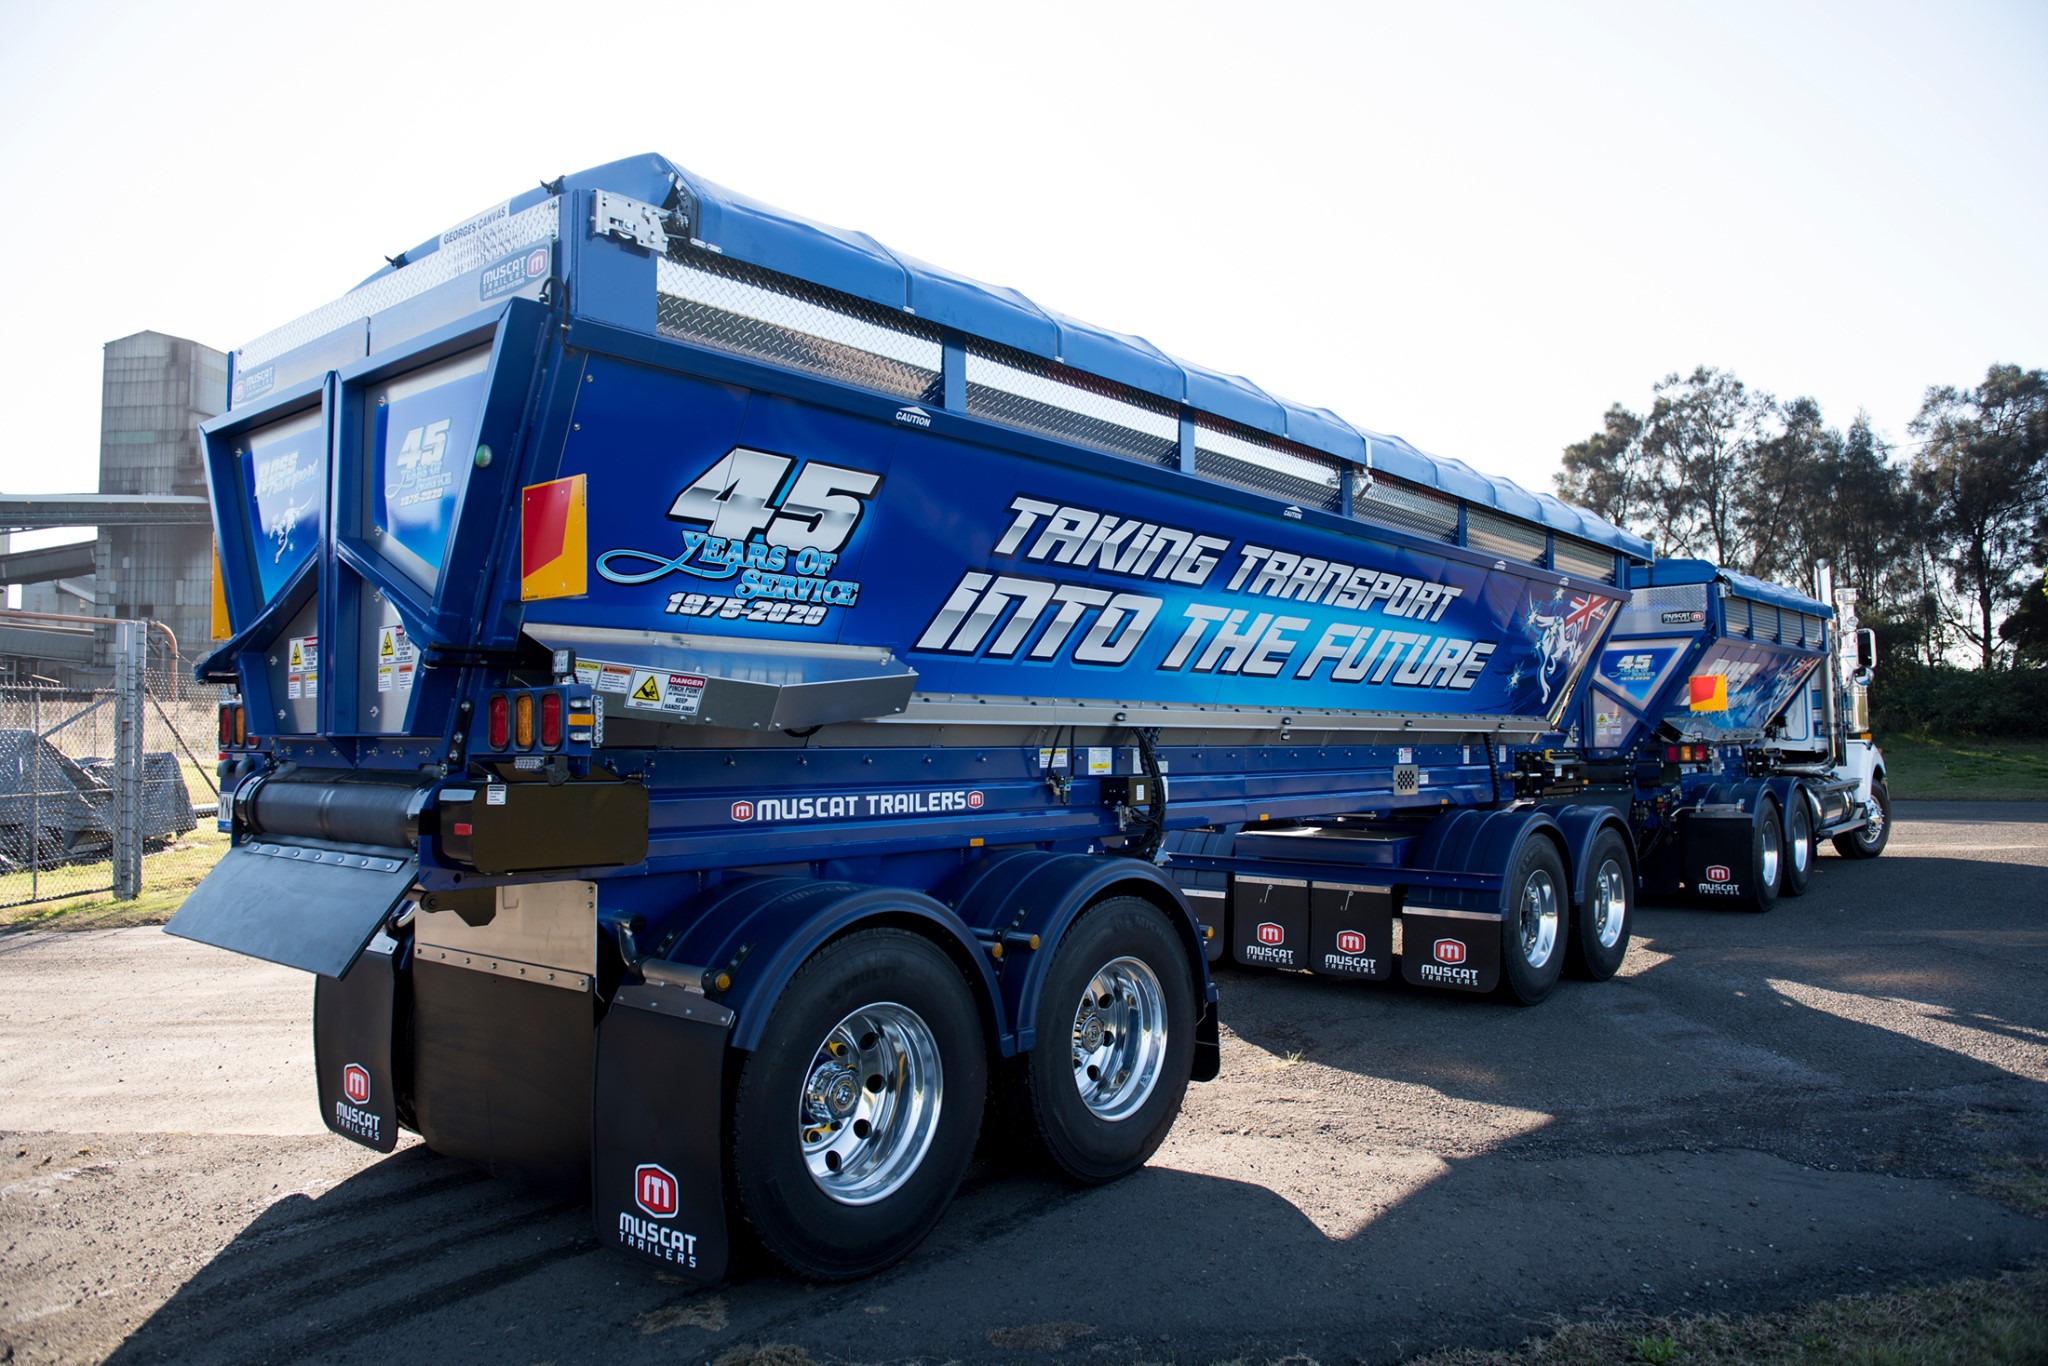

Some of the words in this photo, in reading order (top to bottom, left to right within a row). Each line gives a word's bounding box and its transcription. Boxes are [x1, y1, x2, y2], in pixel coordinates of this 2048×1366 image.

[443, 222, 476, 245] GEORGES
[477, 206, 506, 230] CANVAS
[483, 255, 526, 285] MUSCAT
[483, 269, 526, 292] TRAILERS
[895, 411, 931, 428] CAUTION
[396, 418, 451, 470] 45
[667, 446, 882, 552] 45
[795, 547, 838, 577] OF
[994, 496, 1230, 585] TAKING
[1226, 545, 1463, 622] TRANSPORT
[735, 568, 860, 607] SERVICE
[664, 592, 828, 626] 1975-2020
[915, 571, 1163, 662] INTO
[1162, 603, 1312, 675] THE
[1296, 622, 1498, 689] FUTURE
[1617, 654, 1653, 670] 45
[669, 684, 685, 692] PINCH
[685, 687, 701, 695] POINT
[670, 676, 704, 687] DANGER
[664, 703, 681, 711] HANDS
[756, 795, 859, 821] MUSCAT
[865, 791, 967, 815] TRAILERS
[1698, 883, 1740, 892] MUSCAT
[1246, 945, 1294, 959] MUSCAT
[1246, 953, 1294, 965] TRAILERS
[1325, 954, 1377, 969] MUSCAT
[1325, 962, 1376, 975] TRAILERS
[1421, 964, 1479, 980] MUSCAT
[1421, 973, 1478, 986] TRAILERS
[336, 1101, 380, 1131] MUSCAT
[336, 1115, 380, 1141] TRAILERS
[619, 1212, 697, 1255] MUSCAT
[619, 1231, 697, 1268] TRAILERS
